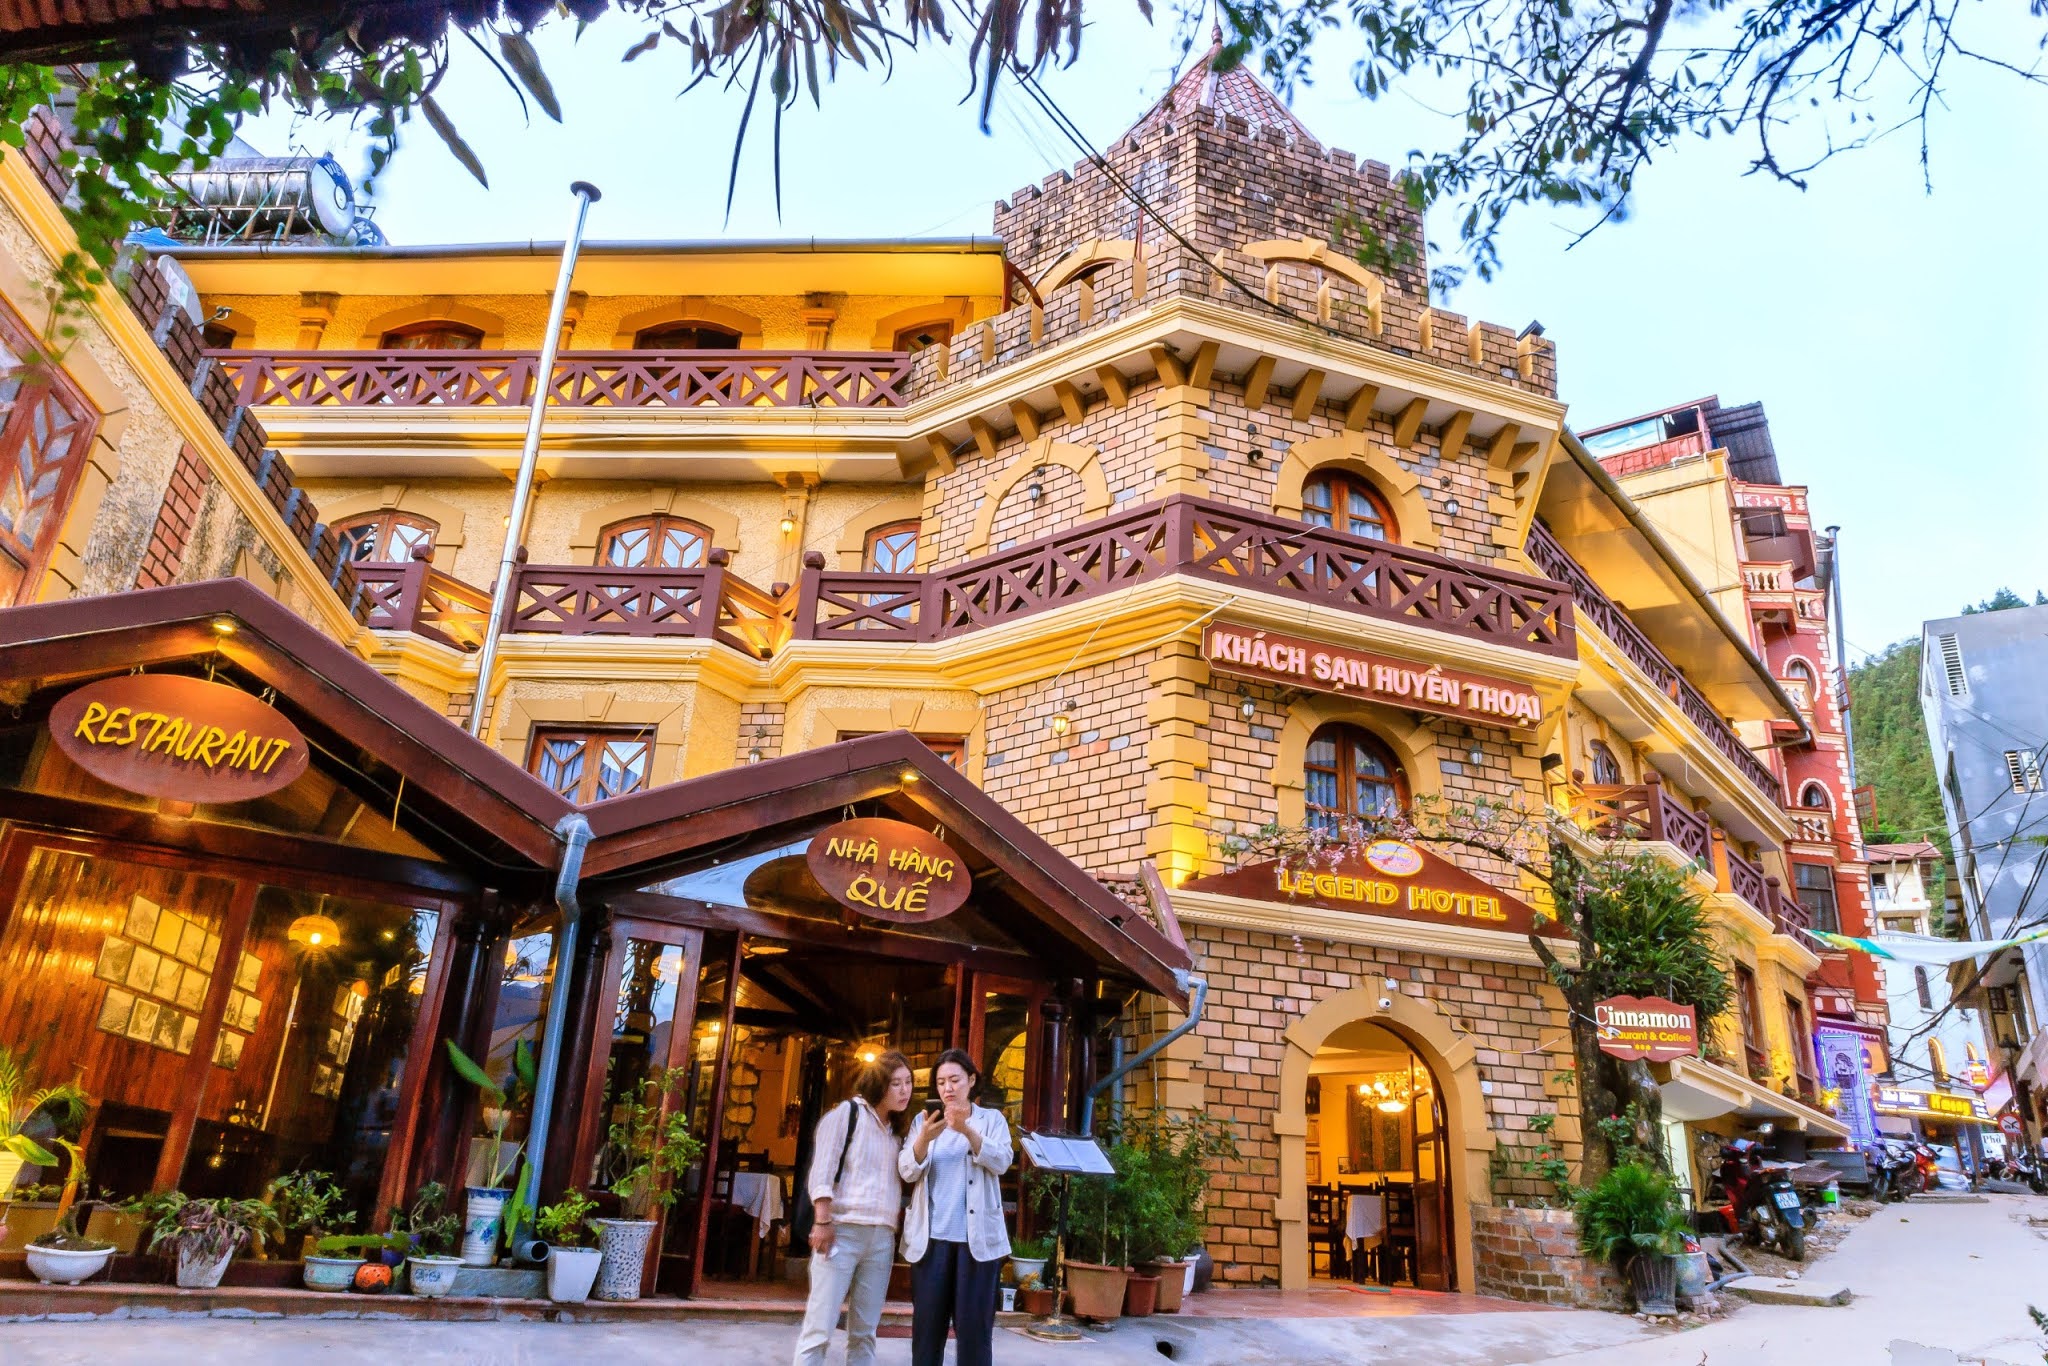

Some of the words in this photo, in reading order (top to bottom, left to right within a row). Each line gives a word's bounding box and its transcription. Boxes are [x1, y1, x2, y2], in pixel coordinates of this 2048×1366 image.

[1211, 632, 1306, 675] KHÁCH
[1311, 653, 1369, 692] SẠN
[1373, 664, 1460, 708] HUYỀN
[1463, 683, 1541, 728] THOẠI
[74, 701, 291, 774] RESTAURANT
[825, 837, 879, 864] NHÀ
[888, 846, 955, 882] HÀNG
[845, 877, 933, 913] QUẾ
[1277, 868, 1399, 905] LEGEND
[1408, 885, 1507, 921] HOTEL
[1594, 1005, 1691, 1029] Cinnamon
[1650, 1031, 1657, 1041] &
[1659, 1032, 1691, 1043] Coffee
